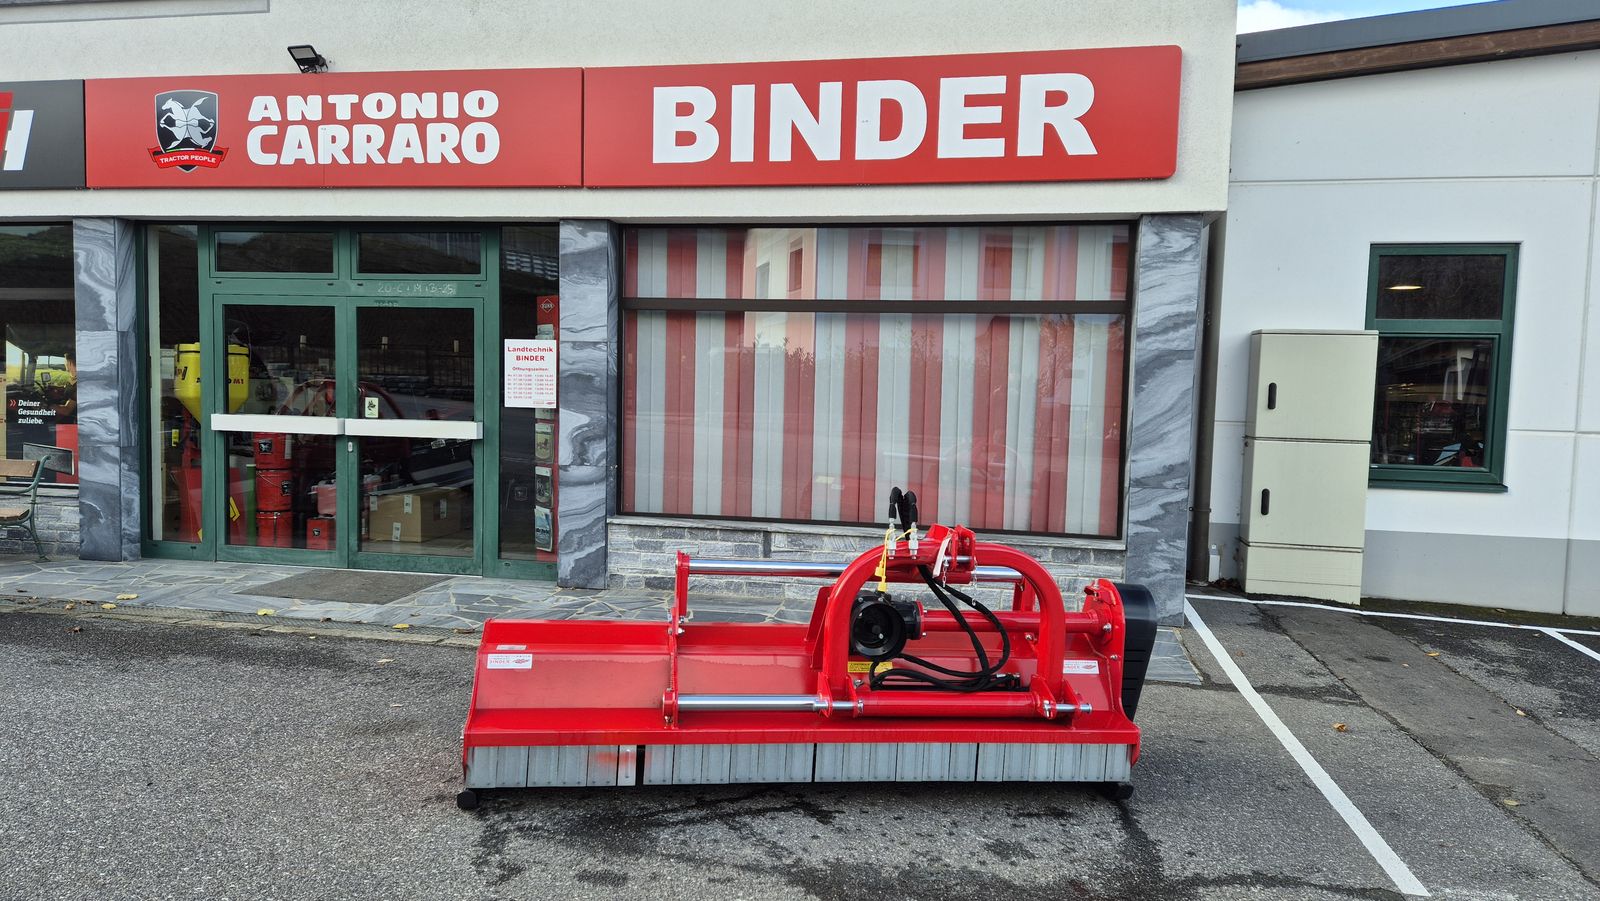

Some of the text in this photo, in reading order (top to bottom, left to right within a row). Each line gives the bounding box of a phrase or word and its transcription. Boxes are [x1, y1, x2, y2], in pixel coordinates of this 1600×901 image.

[247, 90, 499, 121] ANTONIO
[652, 72, 1098, 164] BINDER
[247, 121, 500, 165] CARRARO
[160, 154, 217, 164] TRACTOR PEOPLE
[18, 399, 41, 407] Deiner
[18, 408, 56, 416] Gesundheit
